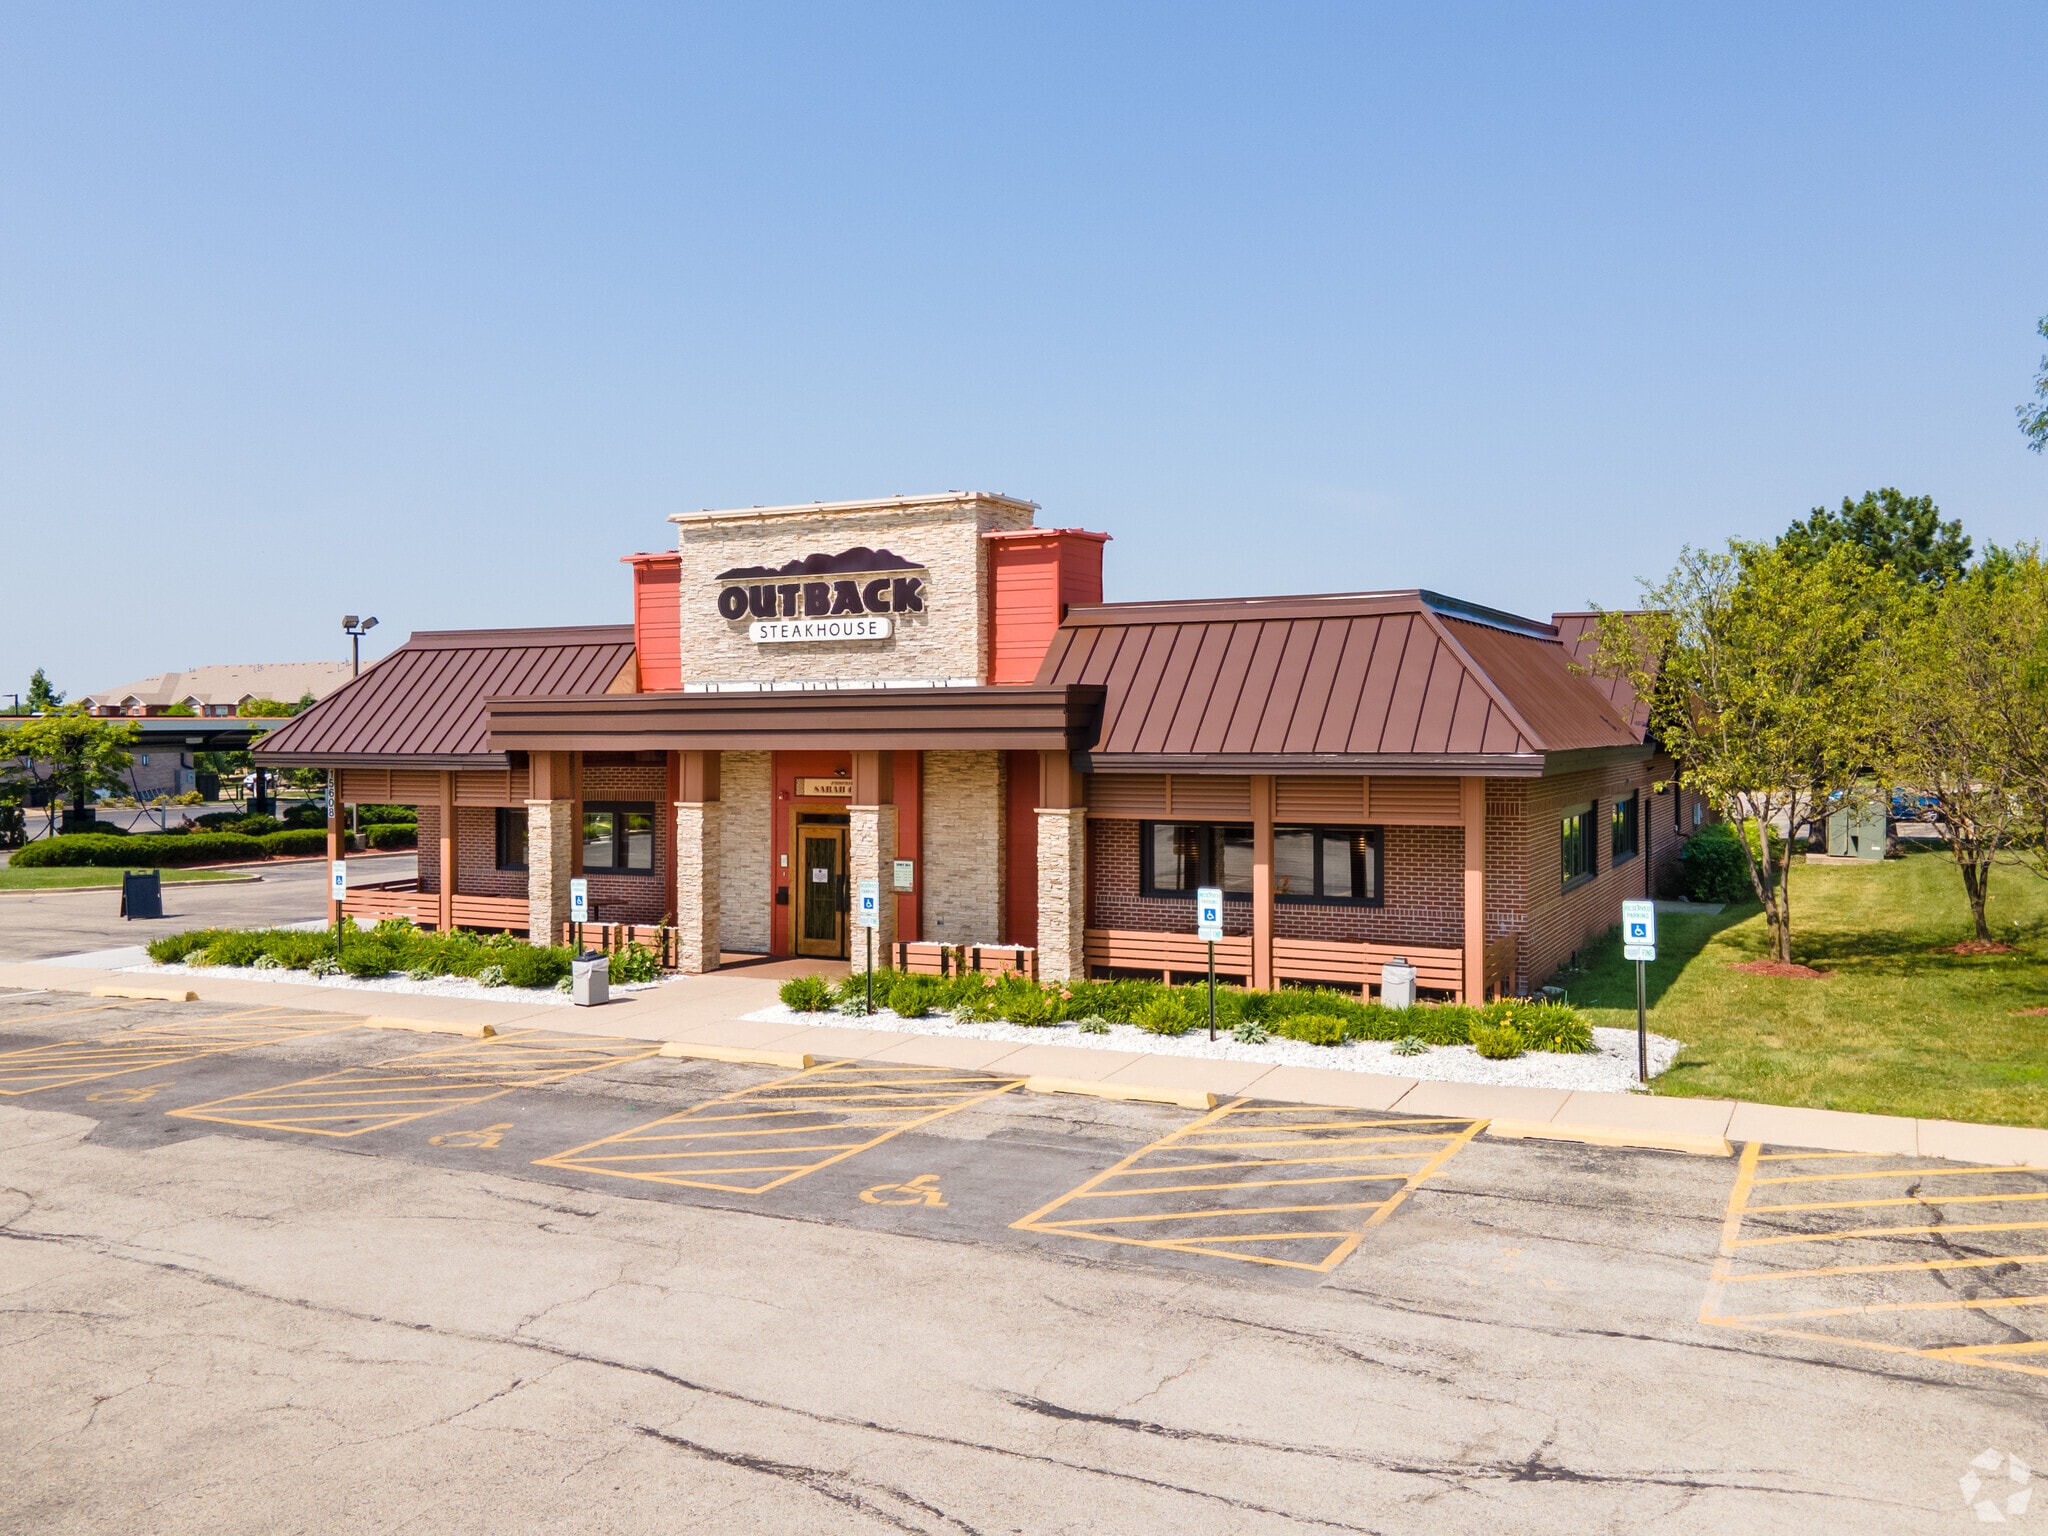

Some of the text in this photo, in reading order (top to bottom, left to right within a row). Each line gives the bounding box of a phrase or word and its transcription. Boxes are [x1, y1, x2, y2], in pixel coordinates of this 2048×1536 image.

[718, 577, 924, 621] OUTBACK
[760, 621, 878, 639] STEAKHOUSE
[328, 769, 336, 818] 15608
[1623, 904, 1651, 912] RESERVED
[1641, 949, 1653, 957] FINE
